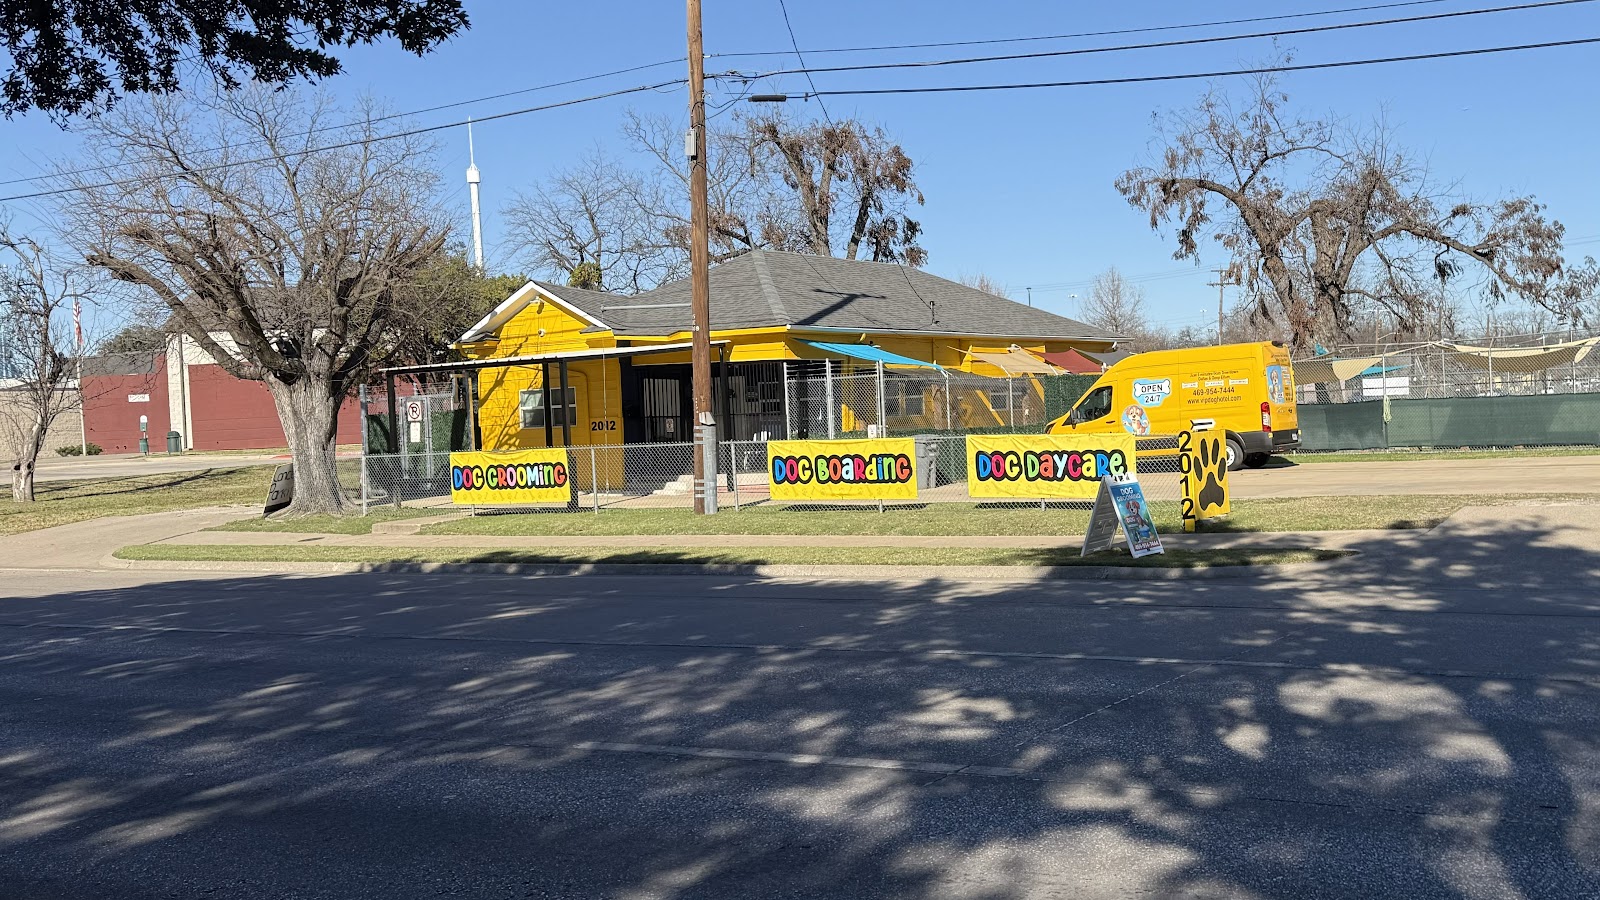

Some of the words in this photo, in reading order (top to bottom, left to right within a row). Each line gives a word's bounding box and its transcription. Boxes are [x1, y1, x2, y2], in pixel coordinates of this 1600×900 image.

[1141, 384, 1163, 393] OPEN
[1192, 387, 1235, 396] 469-954-7444
[1144, 394, 1161, 403] 24/7
[591, 420, 616, 431] 2012
[773, 457, 813, 482] DOG
[977, 452, 1021, 479] DOG
[452, 466, 484, 489] DOG
[1120, 487, 1133, 495] DOG
